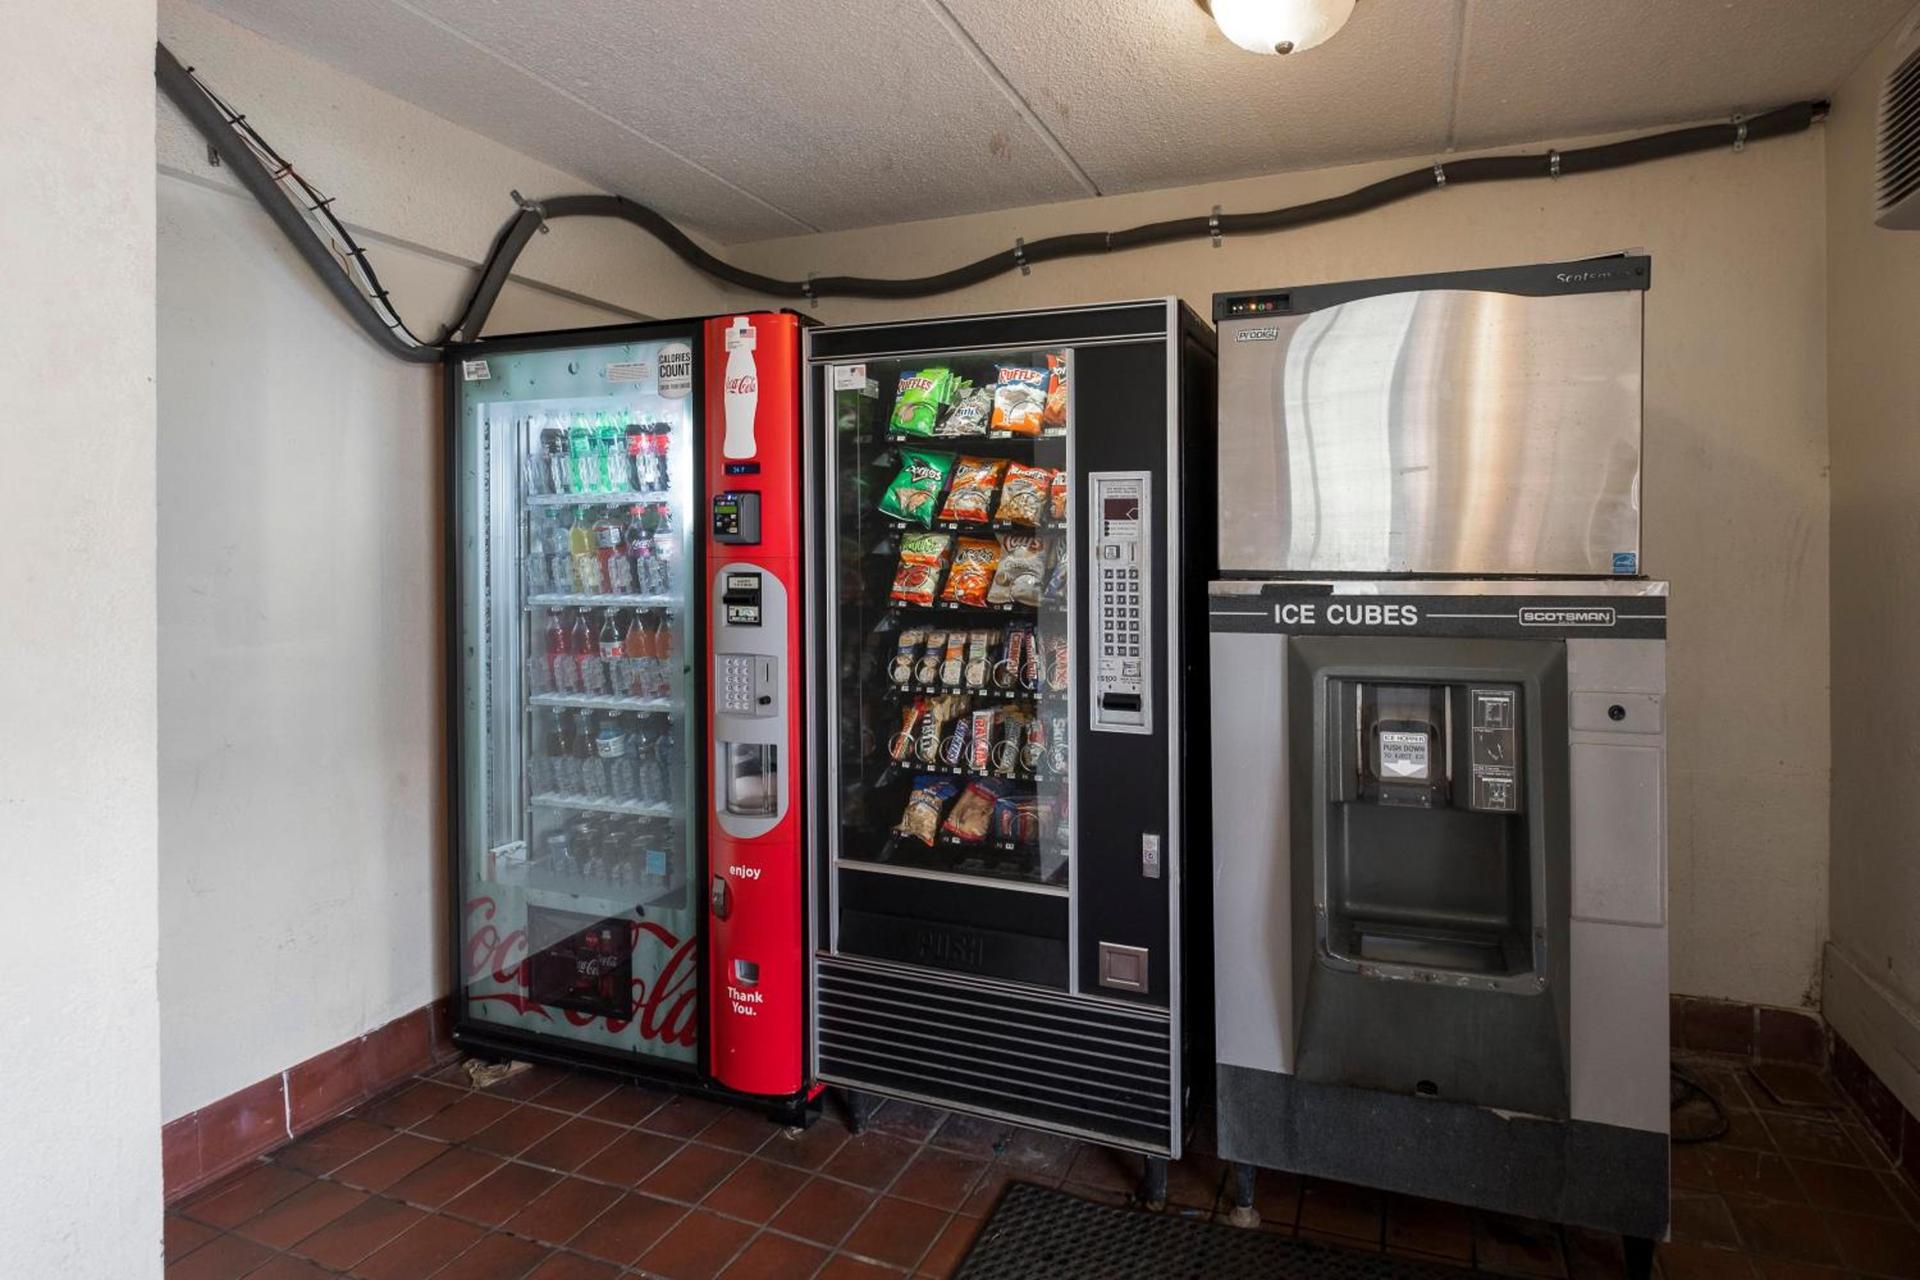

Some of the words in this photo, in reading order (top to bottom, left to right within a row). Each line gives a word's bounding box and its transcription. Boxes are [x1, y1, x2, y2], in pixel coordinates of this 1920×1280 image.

[658, 352, 691, 364] CALORIES
[660, 363, 690, 378] COUNT
[1275, 604, 1315, 624] ICE
[1326, 604, 1418, 626] CUBES
[1524, 612, 1610, 621] SCOTSMAN
[729, 865, 761, 880] enjoy
[727, 986, 763, 1004] Thank
[732, 1001, 757, 1016] You.
